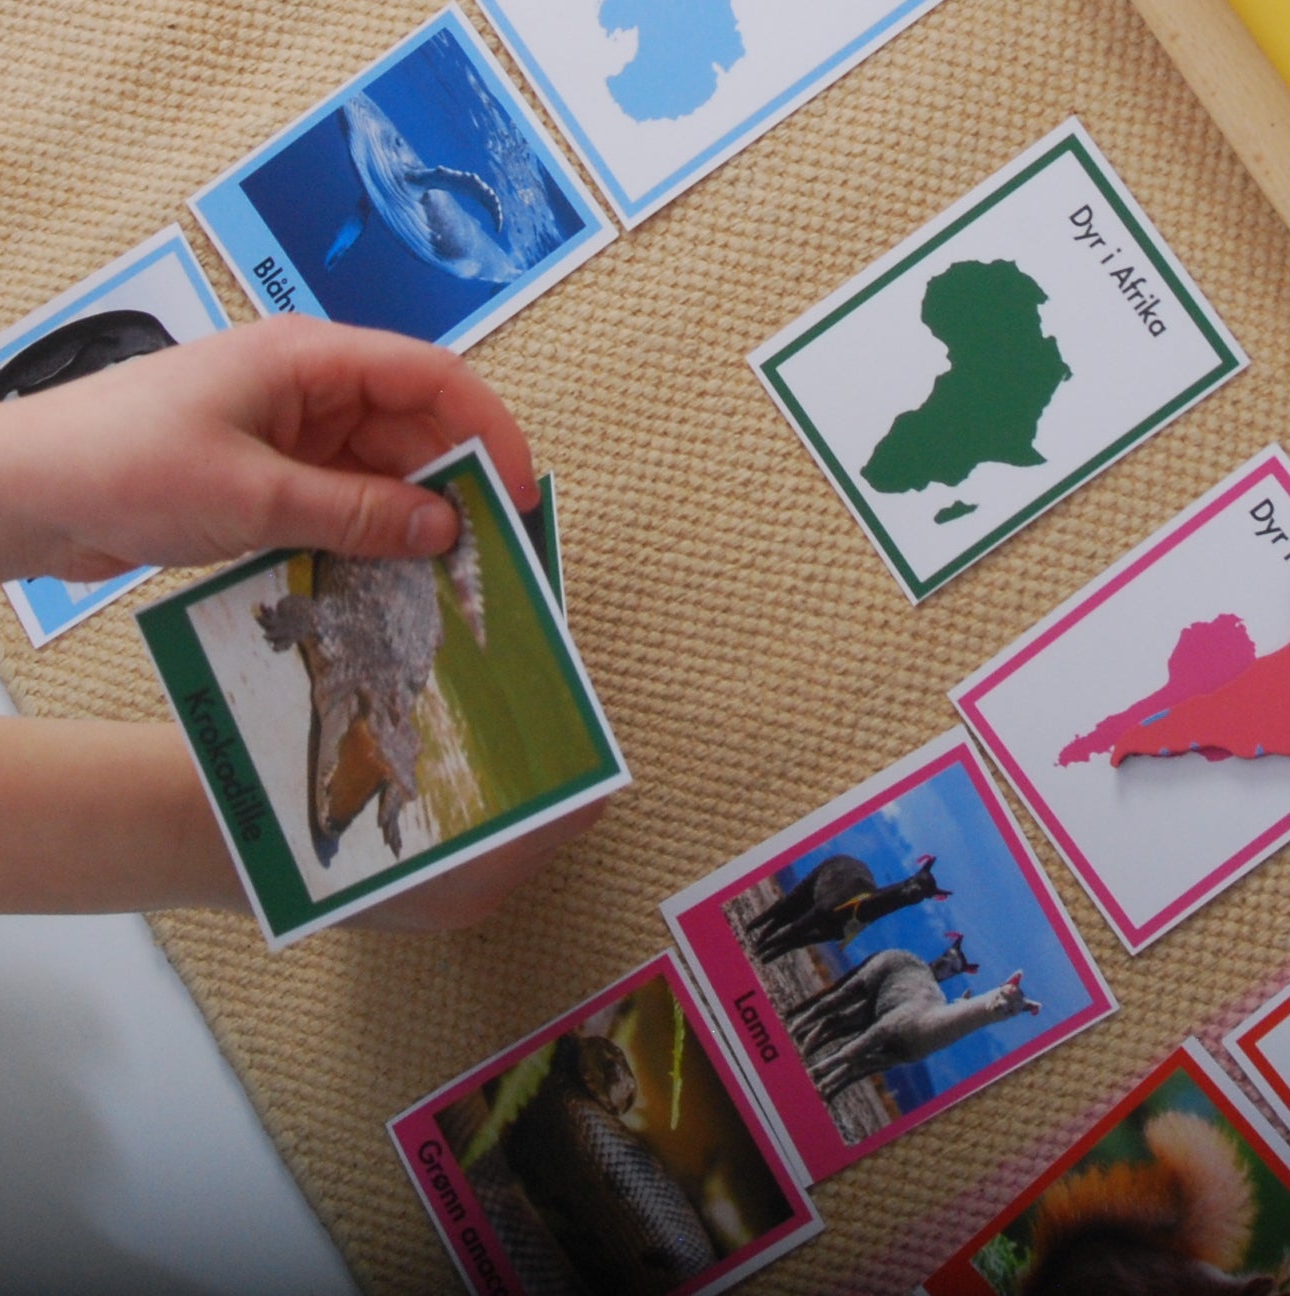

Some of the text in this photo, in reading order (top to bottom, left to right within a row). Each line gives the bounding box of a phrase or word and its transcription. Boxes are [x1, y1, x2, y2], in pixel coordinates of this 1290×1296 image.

[1069, 204, 1167, 338] Dyr i Afrika
[1249, 498, 1289, 544] Dyr
[184, 687, 267, 842] Krokodille
[734, 990, 780, 1063] Lama
[418, 1140, 467, 1222] Grønn
